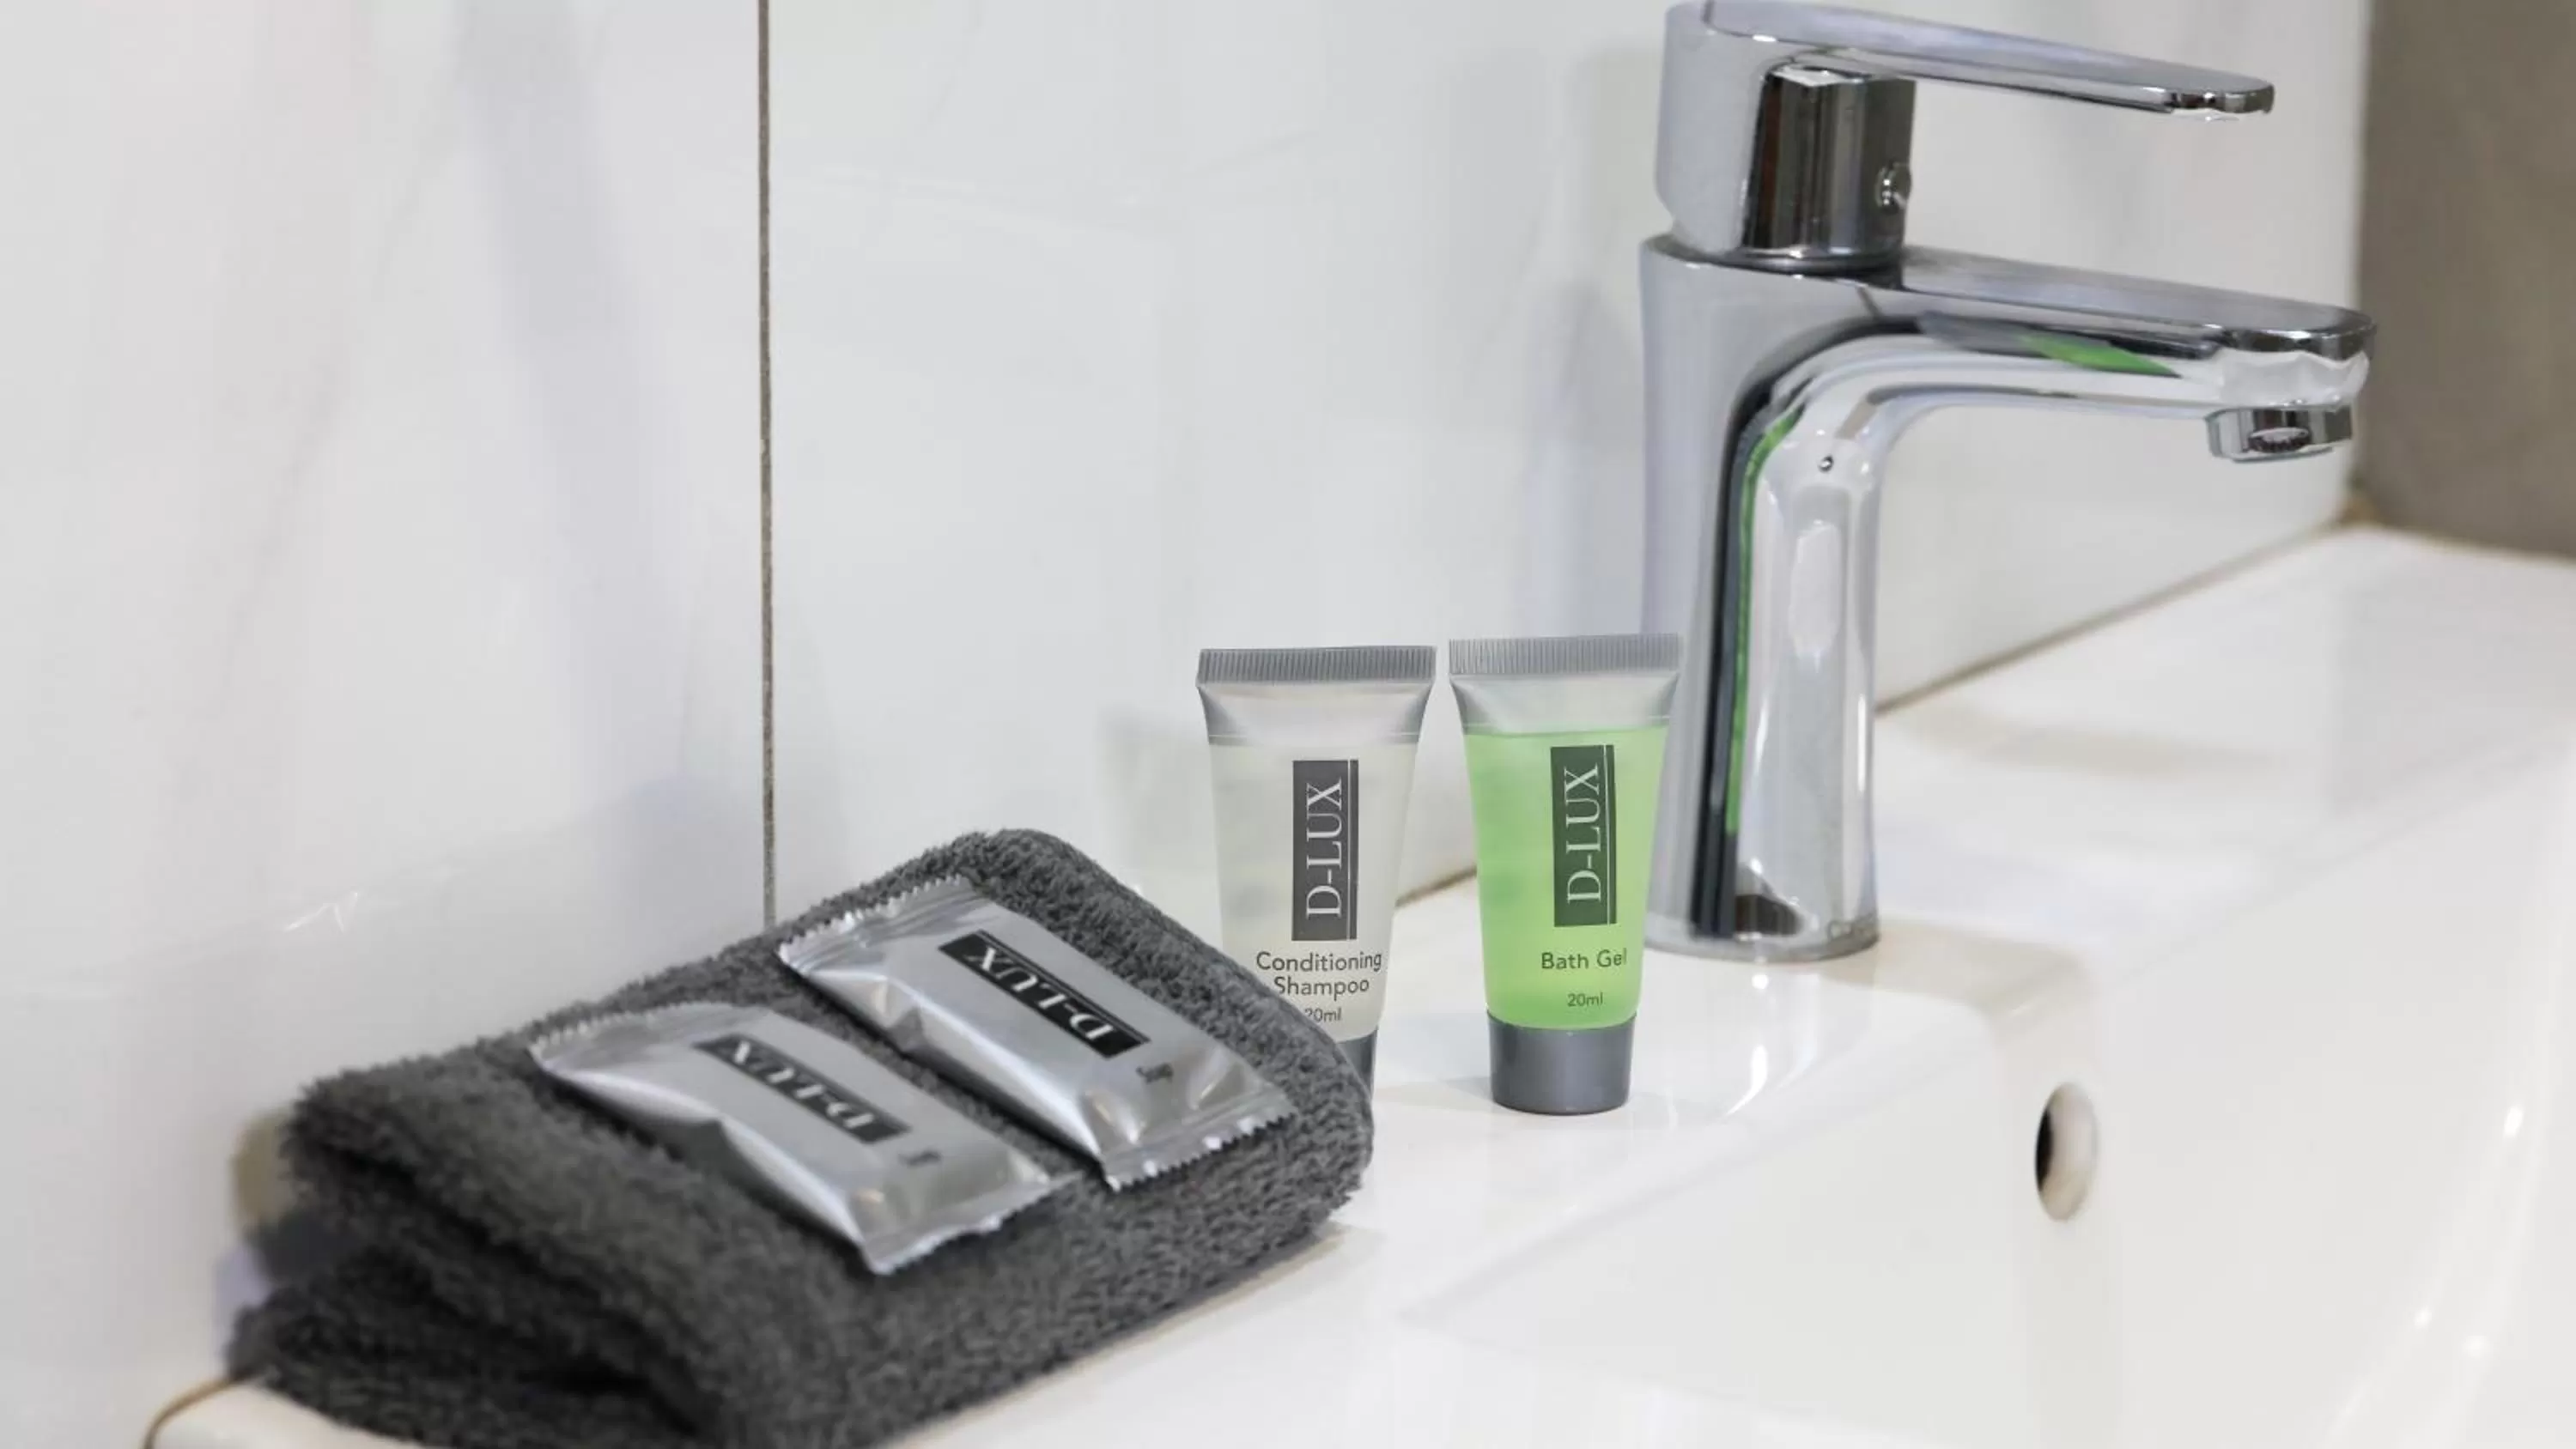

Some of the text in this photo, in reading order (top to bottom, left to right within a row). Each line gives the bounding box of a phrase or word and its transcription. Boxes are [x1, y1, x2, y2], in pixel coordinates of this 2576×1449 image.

[1563, 763, 1601, 904] D-LUX
[1305, 778, 1342, 919] D-LUX
[1256, 950, 1382, 972] Conditioning
[1541, 948, 1627, 969] Bath Gel
[963, 947, 1114, 1040] D-LUX
[1273, 975, 1370, 1001] Shampoo
[1567, 991, 1603, 1007] 20ml
